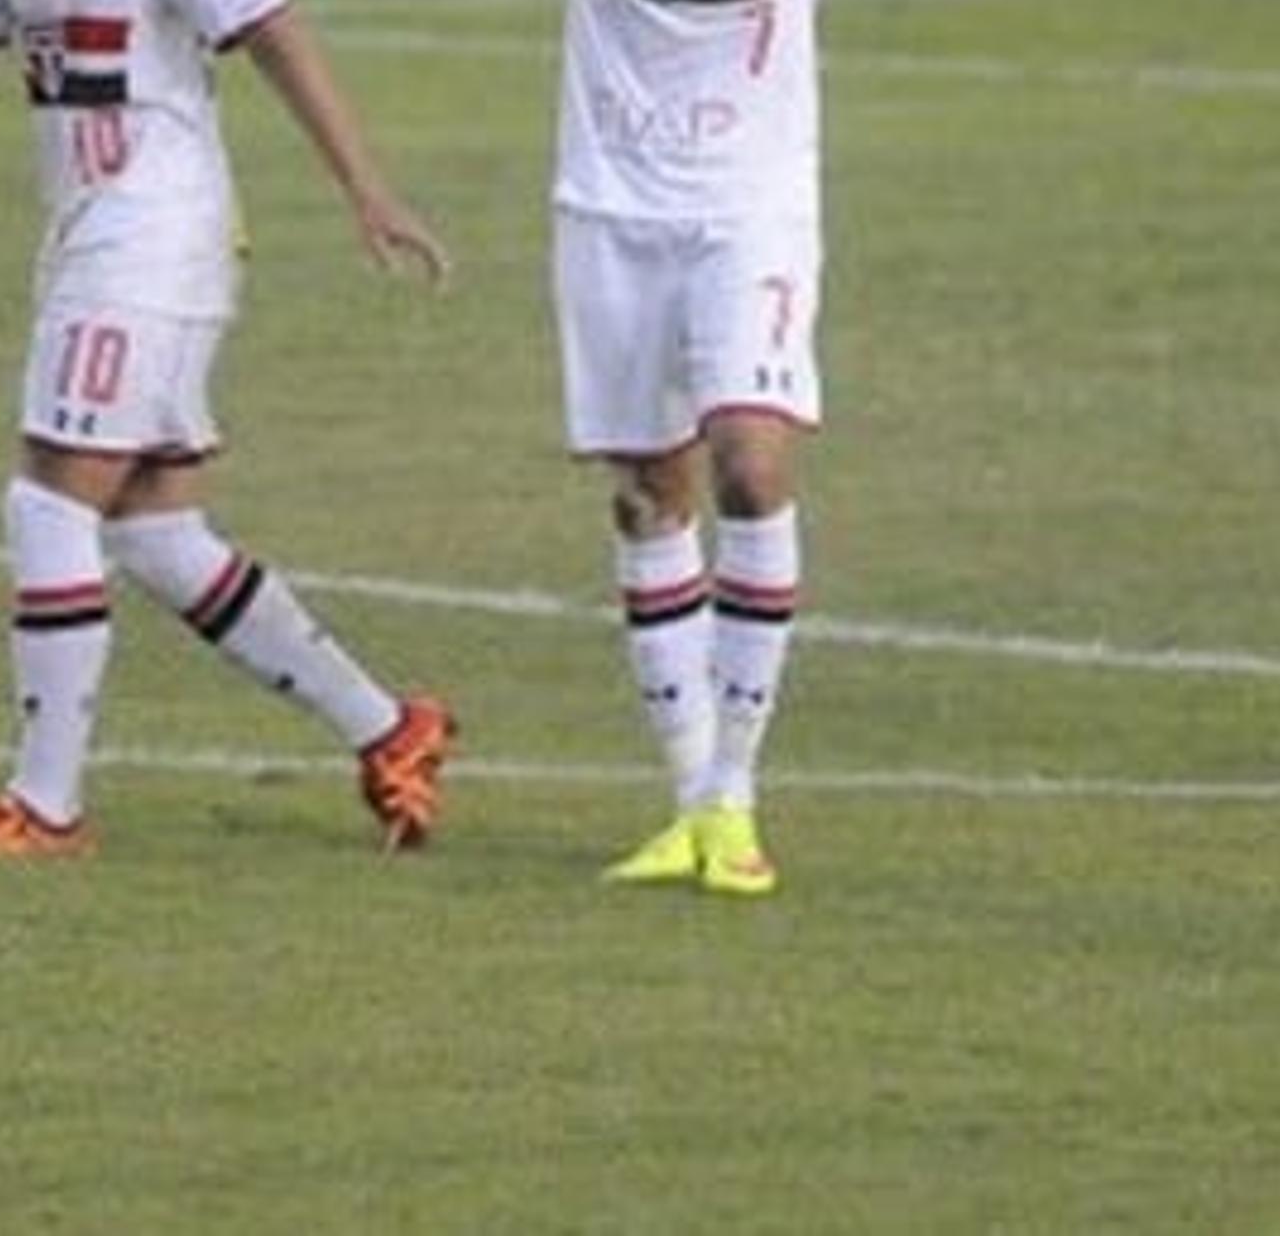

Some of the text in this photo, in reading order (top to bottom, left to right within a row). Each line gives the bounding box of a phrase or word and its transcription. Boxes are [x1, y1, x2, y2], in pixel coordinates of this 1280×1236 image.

[70, 106, 132, 186] 10
[756, 272, 794, 352] 7
[55, 320, 129, 405] 10
